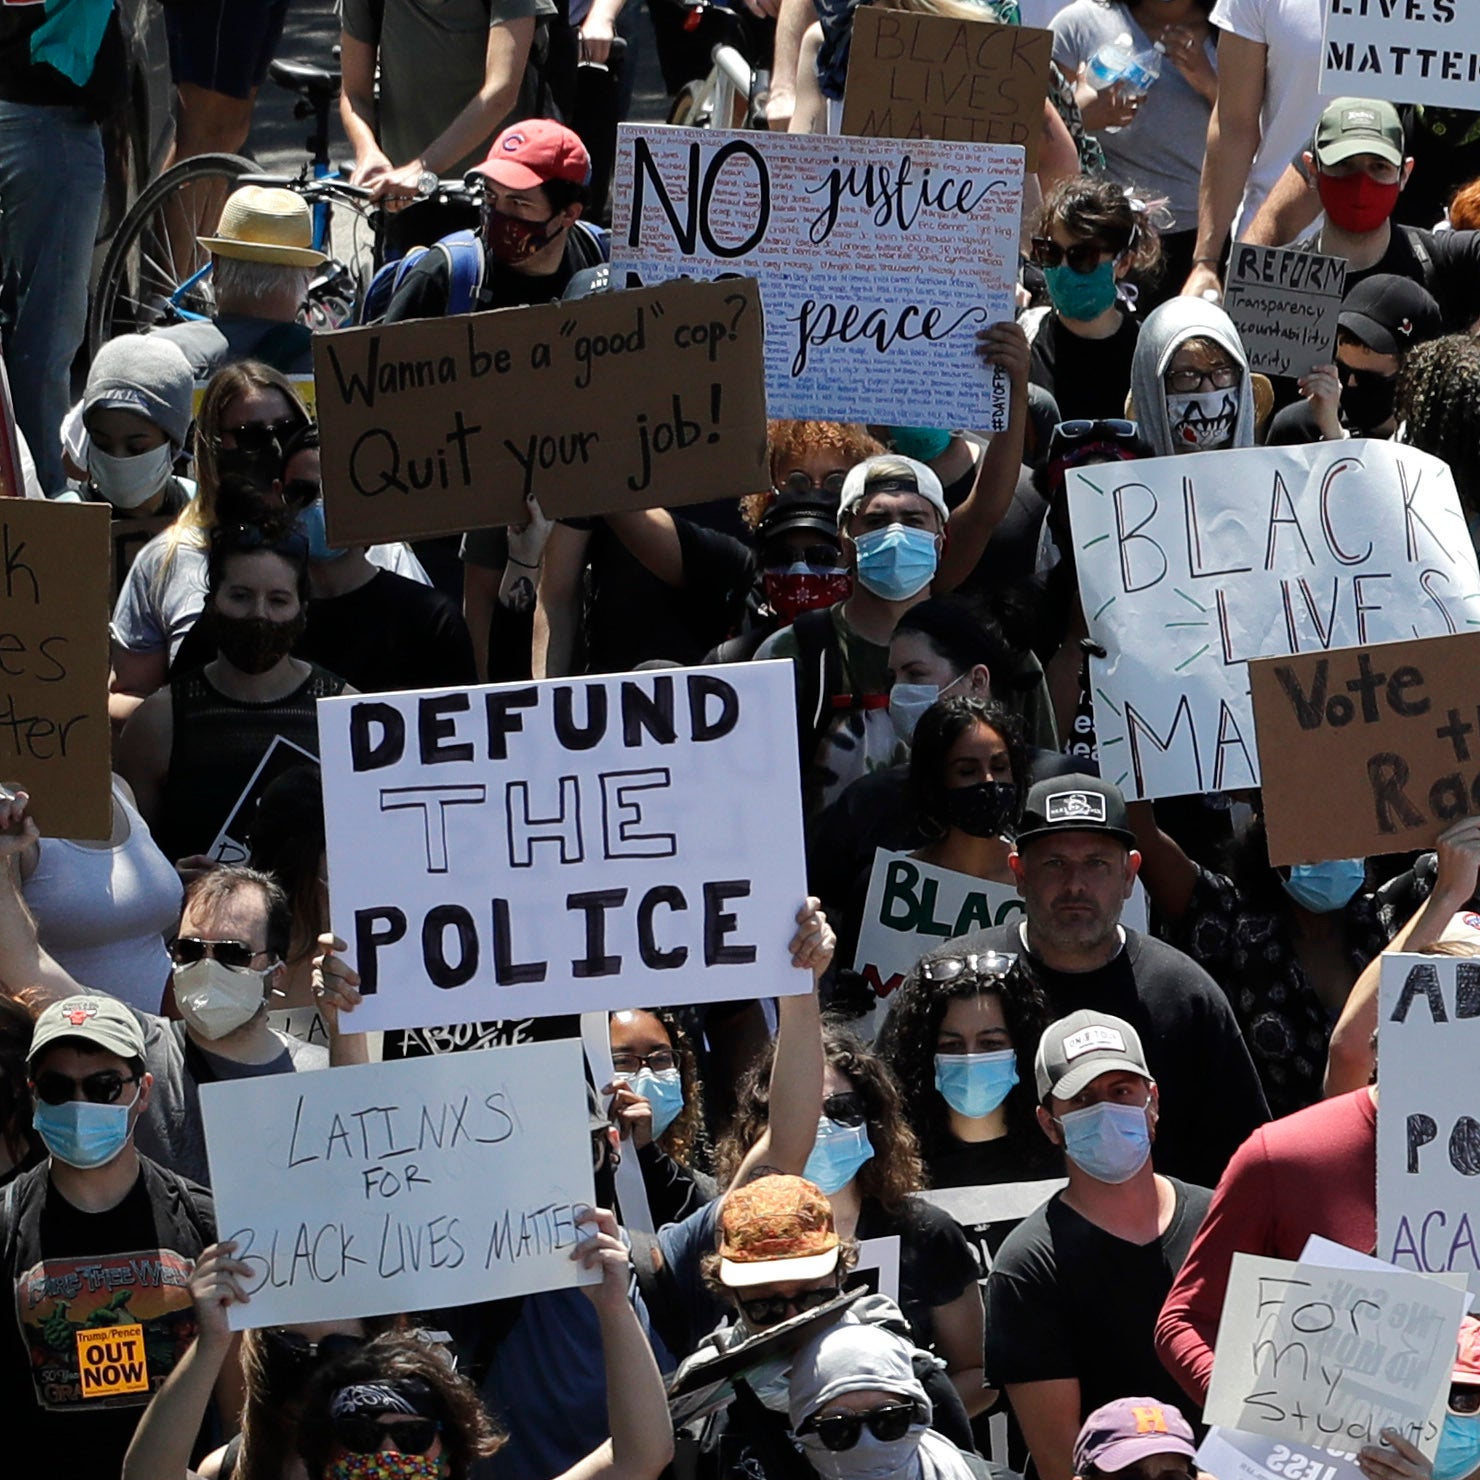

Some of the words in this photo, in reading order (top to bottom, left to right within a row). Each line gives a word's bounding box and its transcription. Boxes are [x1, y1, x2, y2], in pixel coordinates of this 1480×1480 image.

[874, 16, 1045, 74] BLACK
[890, 65, 1022, 112] LIVES
[627, 136, 770, 258] NO
[805, 154, 1008, 246] justice
[1237, 247, 1346, 295] REFORM
[1227, 286, 1326, 326] Transparency
[327, 338, 457, 406] Wanna
[468, 332, 511, 381] be
[529, 340, 552, 370] a
[674, 293, 748, 363] cop?
[348, 412, 482, 500] Quit
[503, 432, 600, 500] your
[627, 383, 724, 493] job!
[1112, 457, 1456, 594] BLACK
[1275, 653, 1433, 732] Vote
[350, 674, 740, 773] DEFUND
[379, 767, 679, 874] THE
[356, 878, 758, 996] POLICE
[364, 1164, 432, 1200] FOR
[78, 1327, 142, 1343] Trump/Pence
[1256, 1277, 1381, 1336] For
[83, 1361, 144, 1389] NOW
[86, 1340, 137, 1366] OUT
